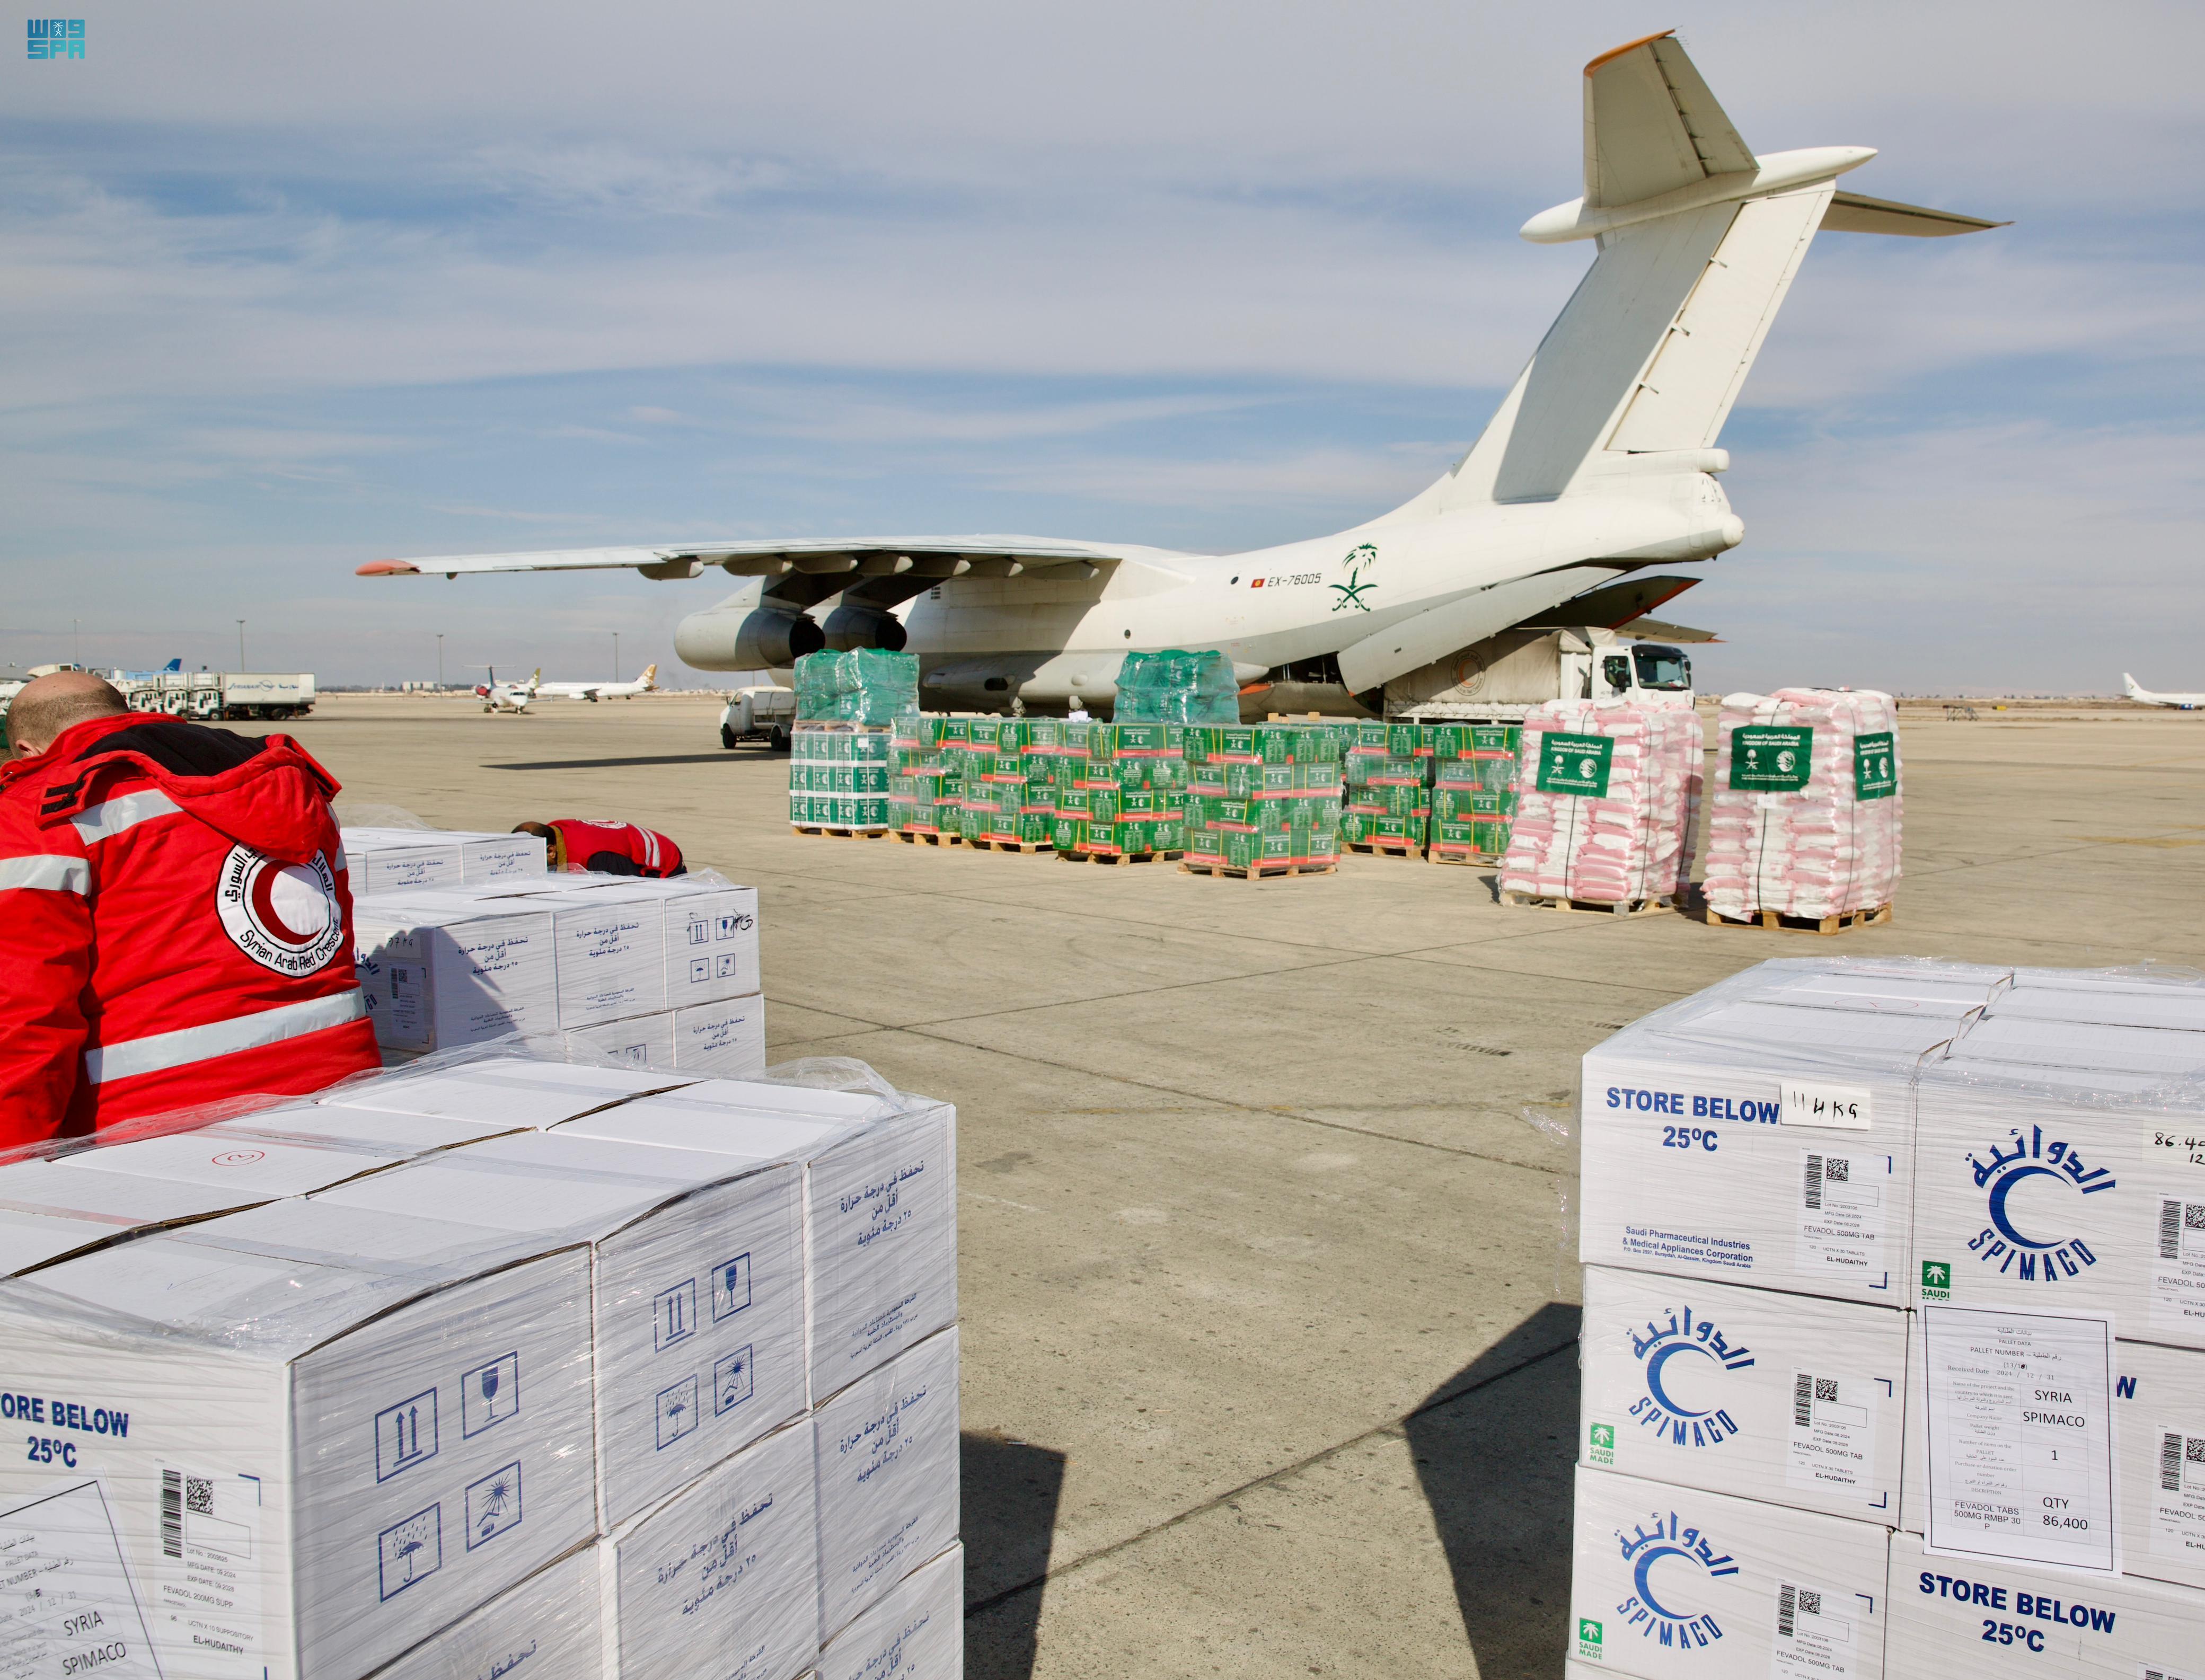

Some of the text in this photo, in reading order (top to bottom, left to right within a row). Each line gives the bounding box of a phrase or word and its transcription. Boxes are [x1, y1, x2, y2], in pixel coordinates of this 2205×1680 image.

[1268, 573, 1321, 587] EX-76005
[610, 925, 618, 934] في
[620, 922, 639, 931] تحفظ
[240, 917, 340, 970] Syrian Arab Red Crescent
[496, 940, 505, 950] في
[507, 937, 528, 945] تحفظ
[458, 947, 475, 955] حرارة
[589, 949, 606, 957] مئوية
[473, 966, 492, 975] مئوية
[1606, 1087, 1780, 1125] STORE BELOW
[1965, 1124, 2116, 1194] الدوائية
[841, 1161, 923, 1213] تحفظ في درجة حرارة
[883, 1216, 901, 1231] درجة
[1804, 1225, 1834, 1235] FEVADOL
[1837, 1230, 1859, 1238] 500MG
[858, 1226, 880, 1246] مئوية
[1626, 1226, 1750, 1250] Saudi Pharmaceutical Industries
[1630, 1239, 1659, 1249] Medical
[1661, 1243, 1704, 1255] Appliances
[1707, 1249, 1753, 1262] Corporation
[1968, 1228, 2096, 1281] SPIMACO
[1827, 1256, 1868, 1266] EL-HUDAITHY
[2158, 1277, 2194, 1288] FEVADOL
[1921, 1288, 1950, 1298] SAUDI
[1626, 1304, 1755, 1370] الدوائية
[2035, 1390, 2072, 1403] SYRIA
[0, 1392, 129, 1437] ORE BELOW
[841, 1385, 926, 1453] تحفظ في درجة حرارة
[1629, 1396, 1739, 1447] SPIMACO
[2023, 1411, 2085, 1427] SPIMACO
[883, 1445, 902, 1463] درجة
[1590, 1447, 1613, 1457] SAUDI
[1794, 1442, 1824, 1453] FEVADOL
[1826, 1448, 1848, 1457] 500MG
[2051, 1450, 2058, 1461] 1
[1590, 1455, 1613, 1464] MADE
[858, 1460, 880, 1482] مئوية
[1815, 1472, 1856, 1484] EL-HUDAITHY
[1955, 1501, 2019, 1515] FEVADOL TABS
[2043, 1497, 2069, 1509] QTY
[1954, 1510, 1982, 1520] 500MG
[1984, 1514, 2008, 1523] RMBP
[2160, 1508, 2196, 1519] FEVADOL
[2043, 1515, 2088, 1530] 86,400
[658, 1493, 773, 1584] تحفظ في درجة حرارة
[1614, 1510, 1739, 1577] الدوائية
[6, 1569, 38, 1586] NUMBER
[716, 1566, 743, 1589] درجة
[163, 1585, 233, 1608] FEVADOL 200MG SUPP
[683, 1587, 714, 1614] مئوية
[1919, 1572, 2116, 1633] STORE BELOW
[64, 1611, 104, 1637] SYRIA
[1617, 1596, 1723, 1649] SPIMACO
[193, 1635, 244, 1655] EL-HUDAITHY
[866, 1611, 929, 1671] تحفظ في درجة
[1579, 1642, 1602, 1653] SAUDI
[63, 1642, 126, 1675] SPIMACO
[1579, 1649, 1602, 1660] MADE
[1777, 1650, 1845, 1673] FEVADOL 500MG TAB
